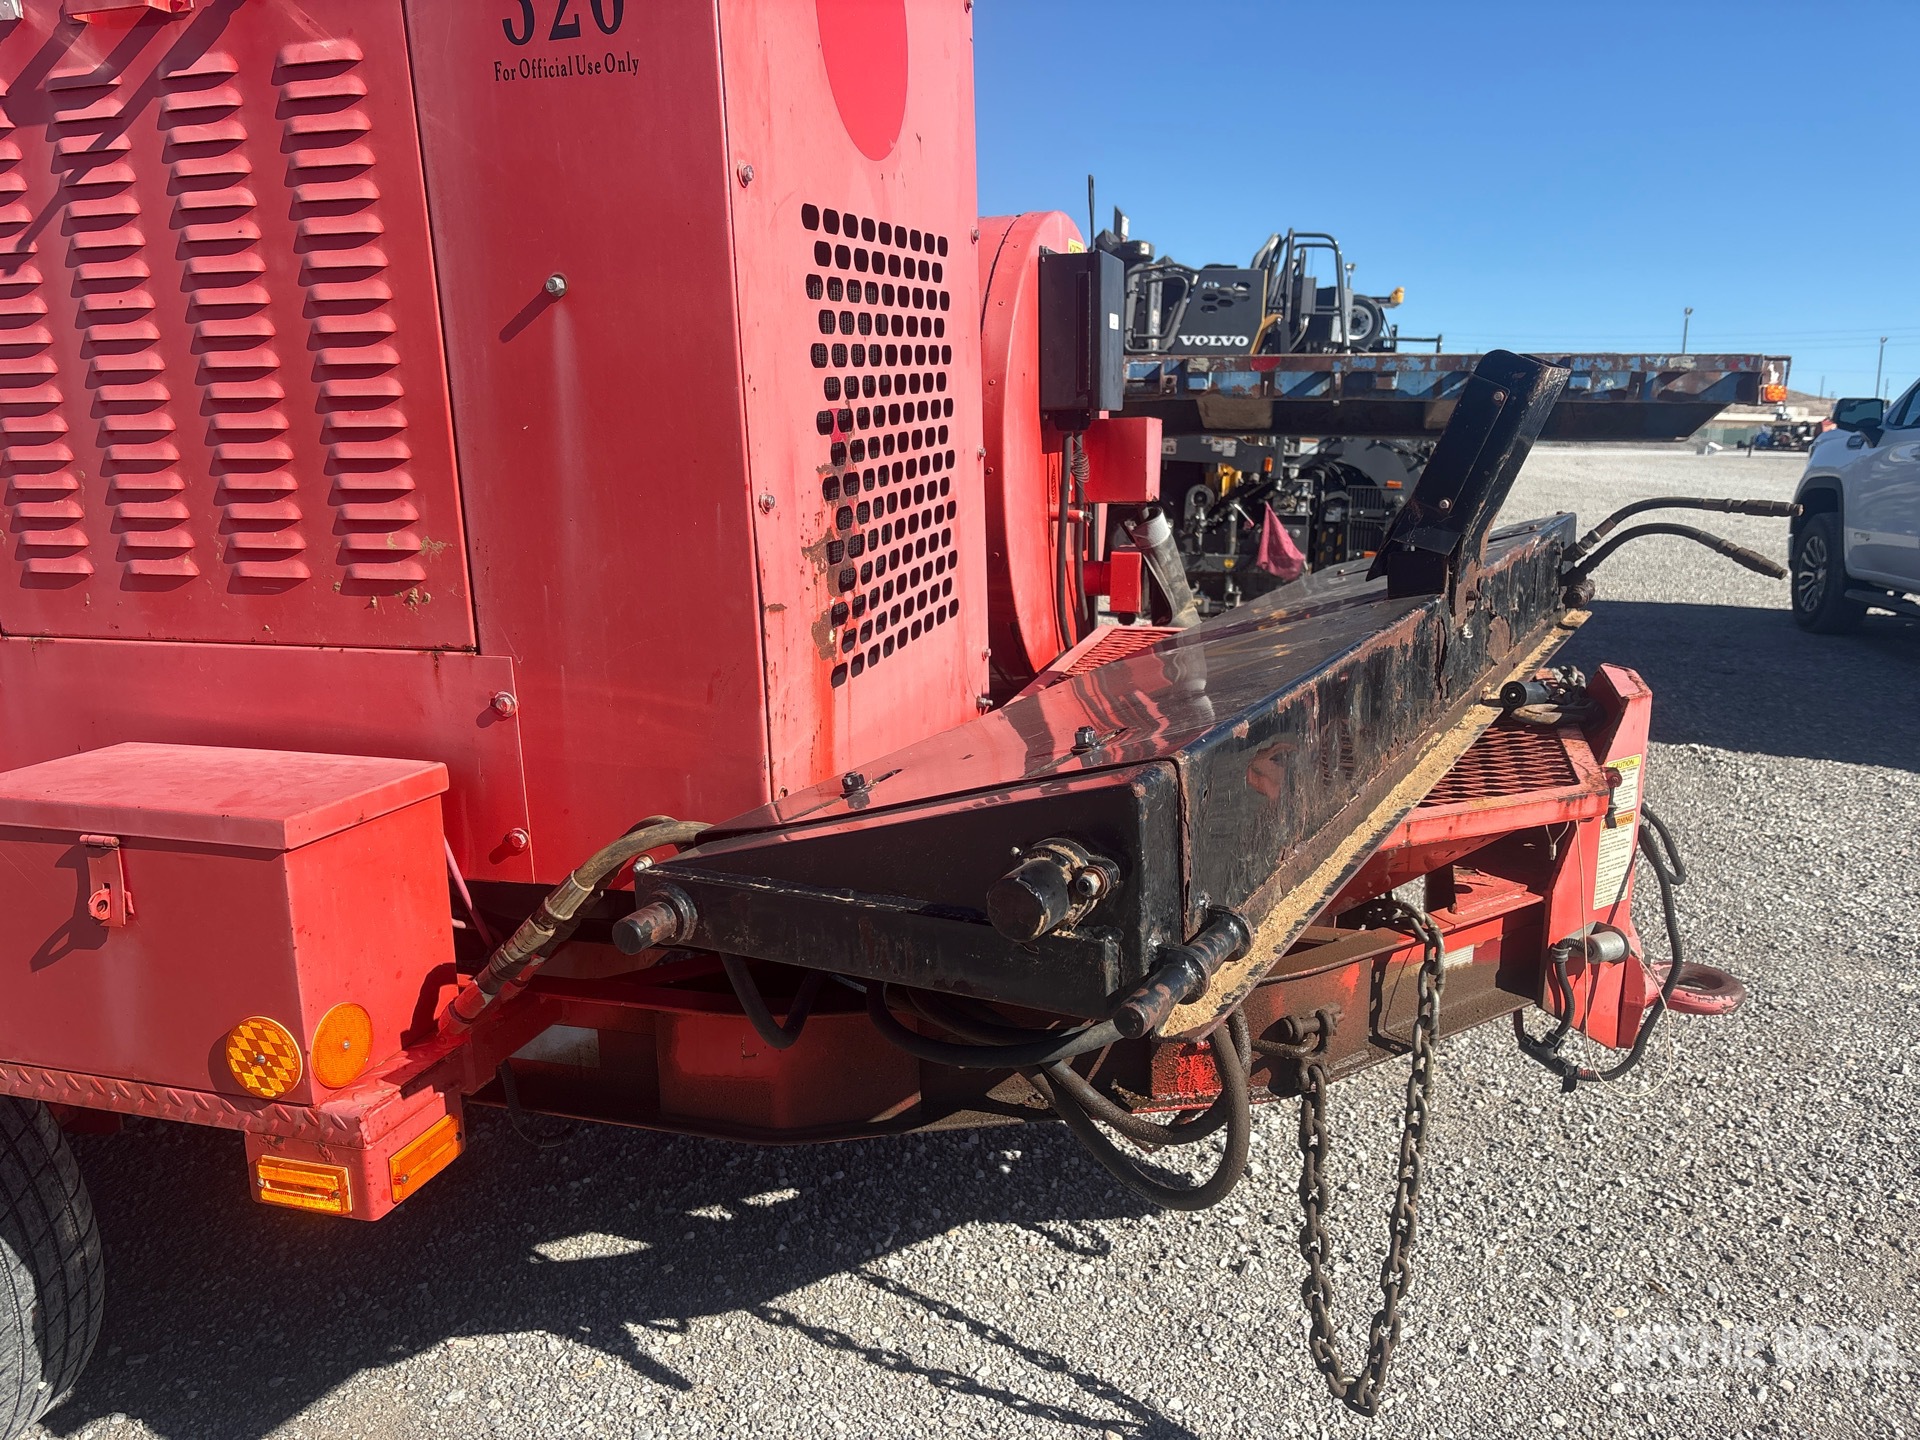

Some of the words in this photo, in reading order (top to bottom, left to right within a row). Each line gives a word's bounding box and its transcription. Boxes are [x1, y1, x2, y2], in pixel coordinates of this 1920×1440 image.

[494, 61, 516, 81] For
[519, 56, 573, 79] Official
[575, 54, 601, 75] Use
[604, 51, 639, 76] Only
[1178, 335, 1249, 346] VOLVO
